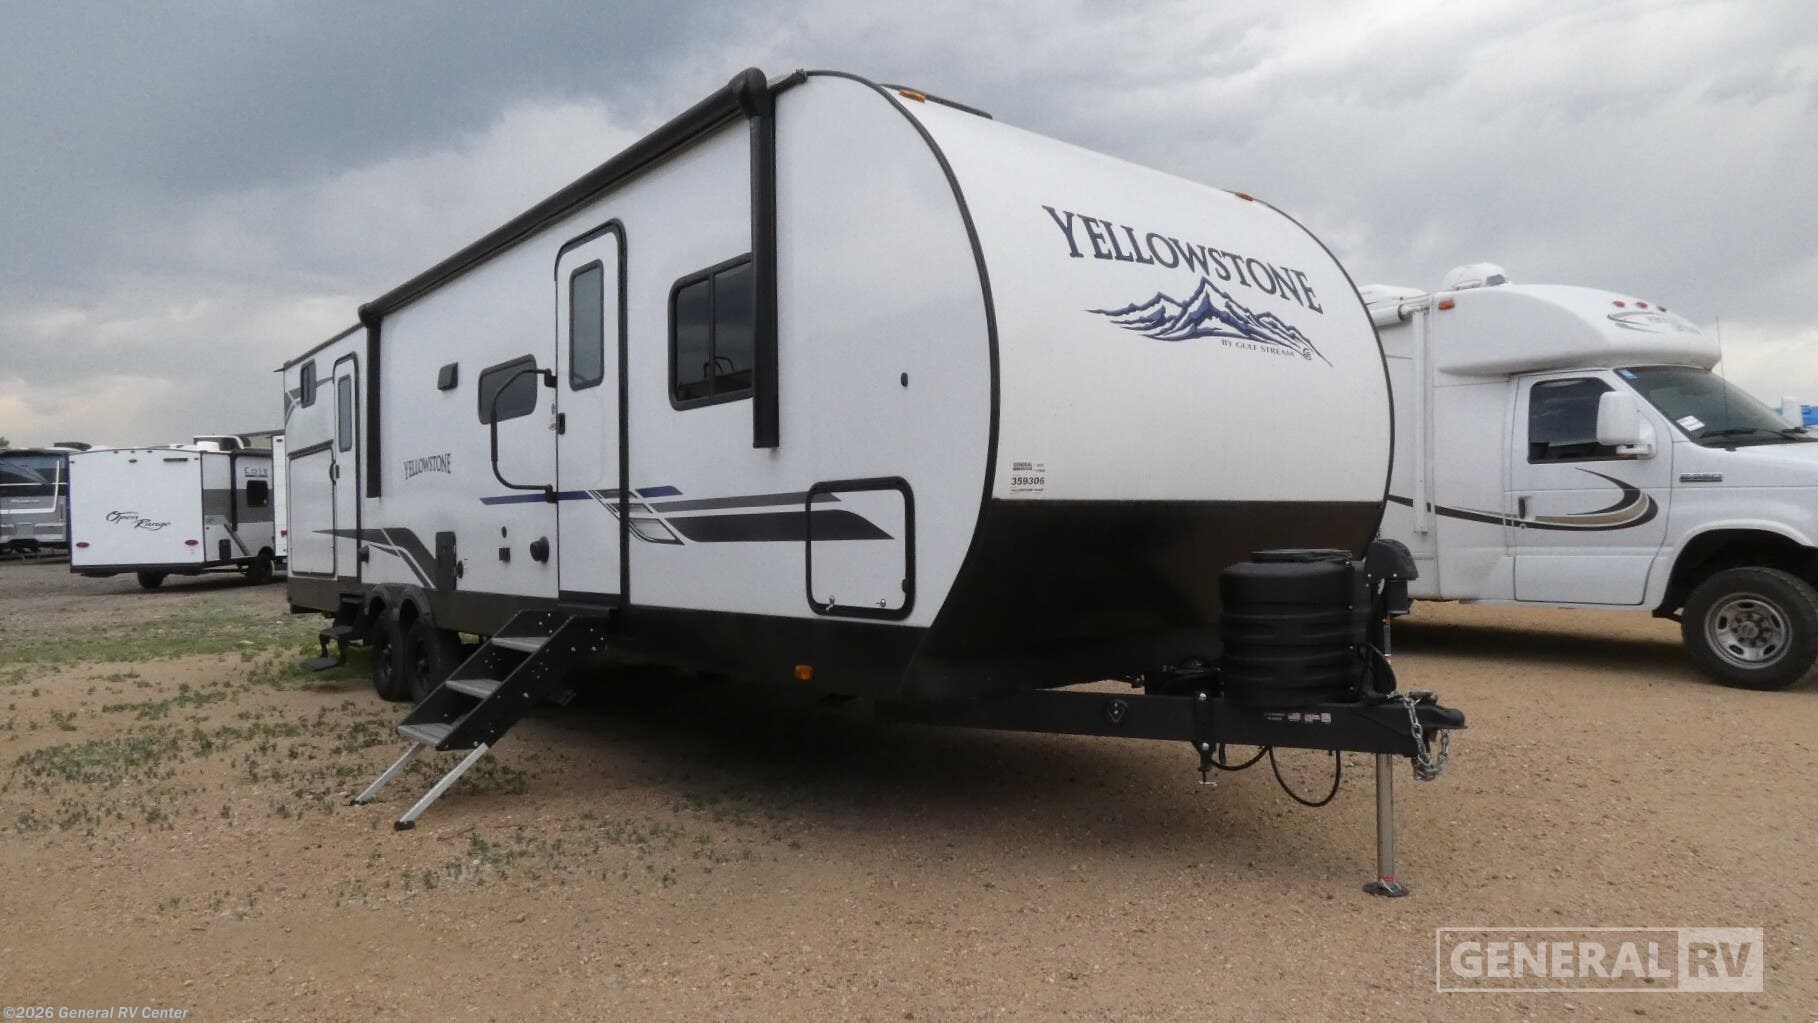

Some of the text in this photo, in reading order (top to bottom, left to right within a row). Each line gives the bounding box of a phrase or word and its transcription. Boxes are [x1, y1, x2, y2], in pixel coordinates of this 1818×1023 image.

[1041, 204, 1324, 315] YELLOWSTONE
[1221, 339, 1295, 357] BY GULF STREAM
[403, 453, 452, 480] YELLOWSTONE
[1011, 476, 1046, 486] 359306
[105, 510, 172, 531] Open Range
